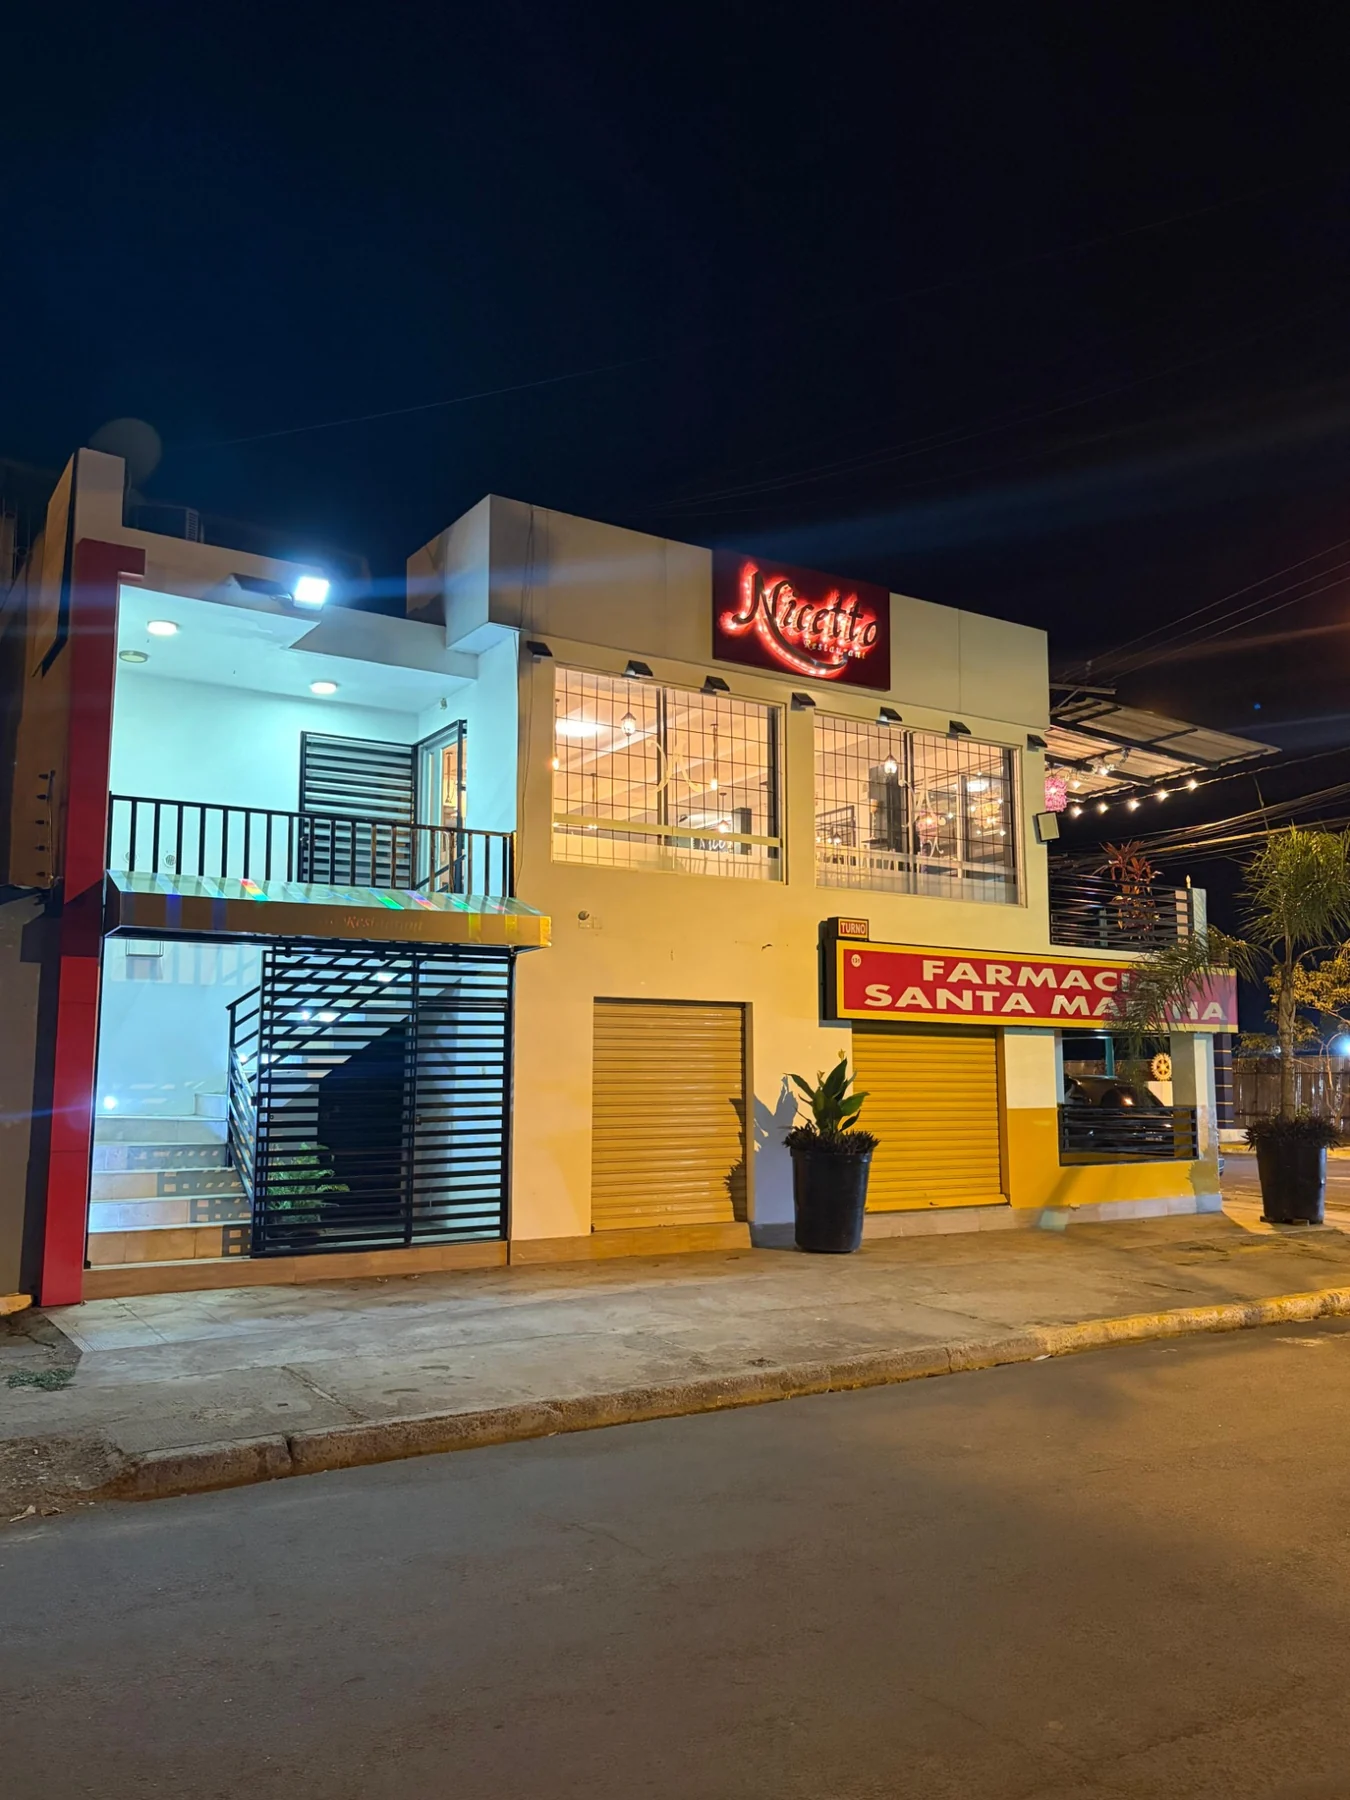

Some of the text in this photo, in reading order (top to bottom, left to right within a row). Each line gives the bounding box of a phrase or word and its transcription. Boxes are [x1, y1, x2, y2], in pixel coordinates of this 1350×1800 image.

[731, 569, 880, 670] Nicetto
[840, 921, 866, 935] TURNO
[864, 984, 1036, 1015] SANTA
